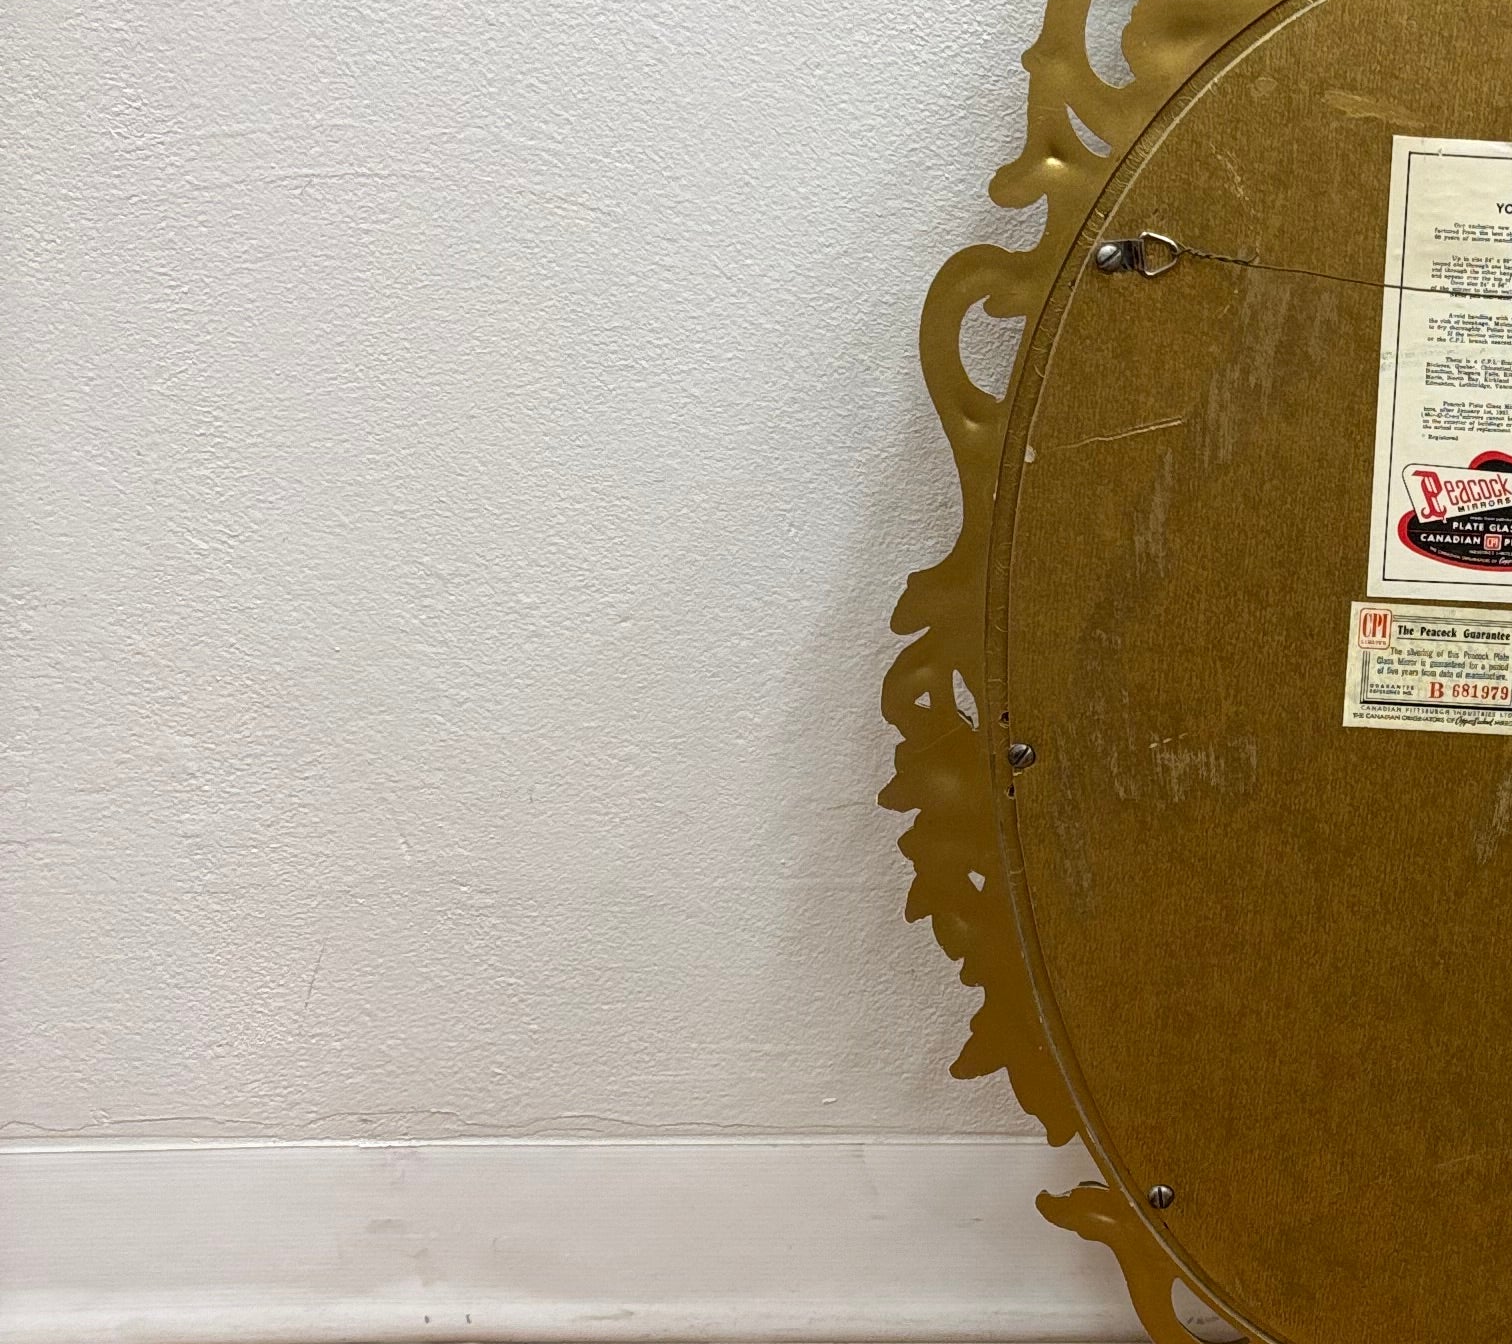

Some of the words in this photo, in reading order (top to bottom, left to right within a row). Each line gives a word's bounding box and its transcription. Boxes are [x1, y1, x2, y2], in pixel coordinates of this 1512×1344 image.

[1412, 470, 1512, 519] Peacock
[1457, 497, 1512, 513] MIRRORS
[1452, 522, 1484, 531] PLATE
[1420, 533, 1481, 545] CANADIAN
[1362, 612, 1389, 639] CPI
[1398, 625, 1415, 635] The
[1420, 626, 1457, 638] Peacock
[1463, 629, 1511, 641] Guarantee
[1428, 682, 1445, 699] B
[1452, 683, 1509, 700] 681979
